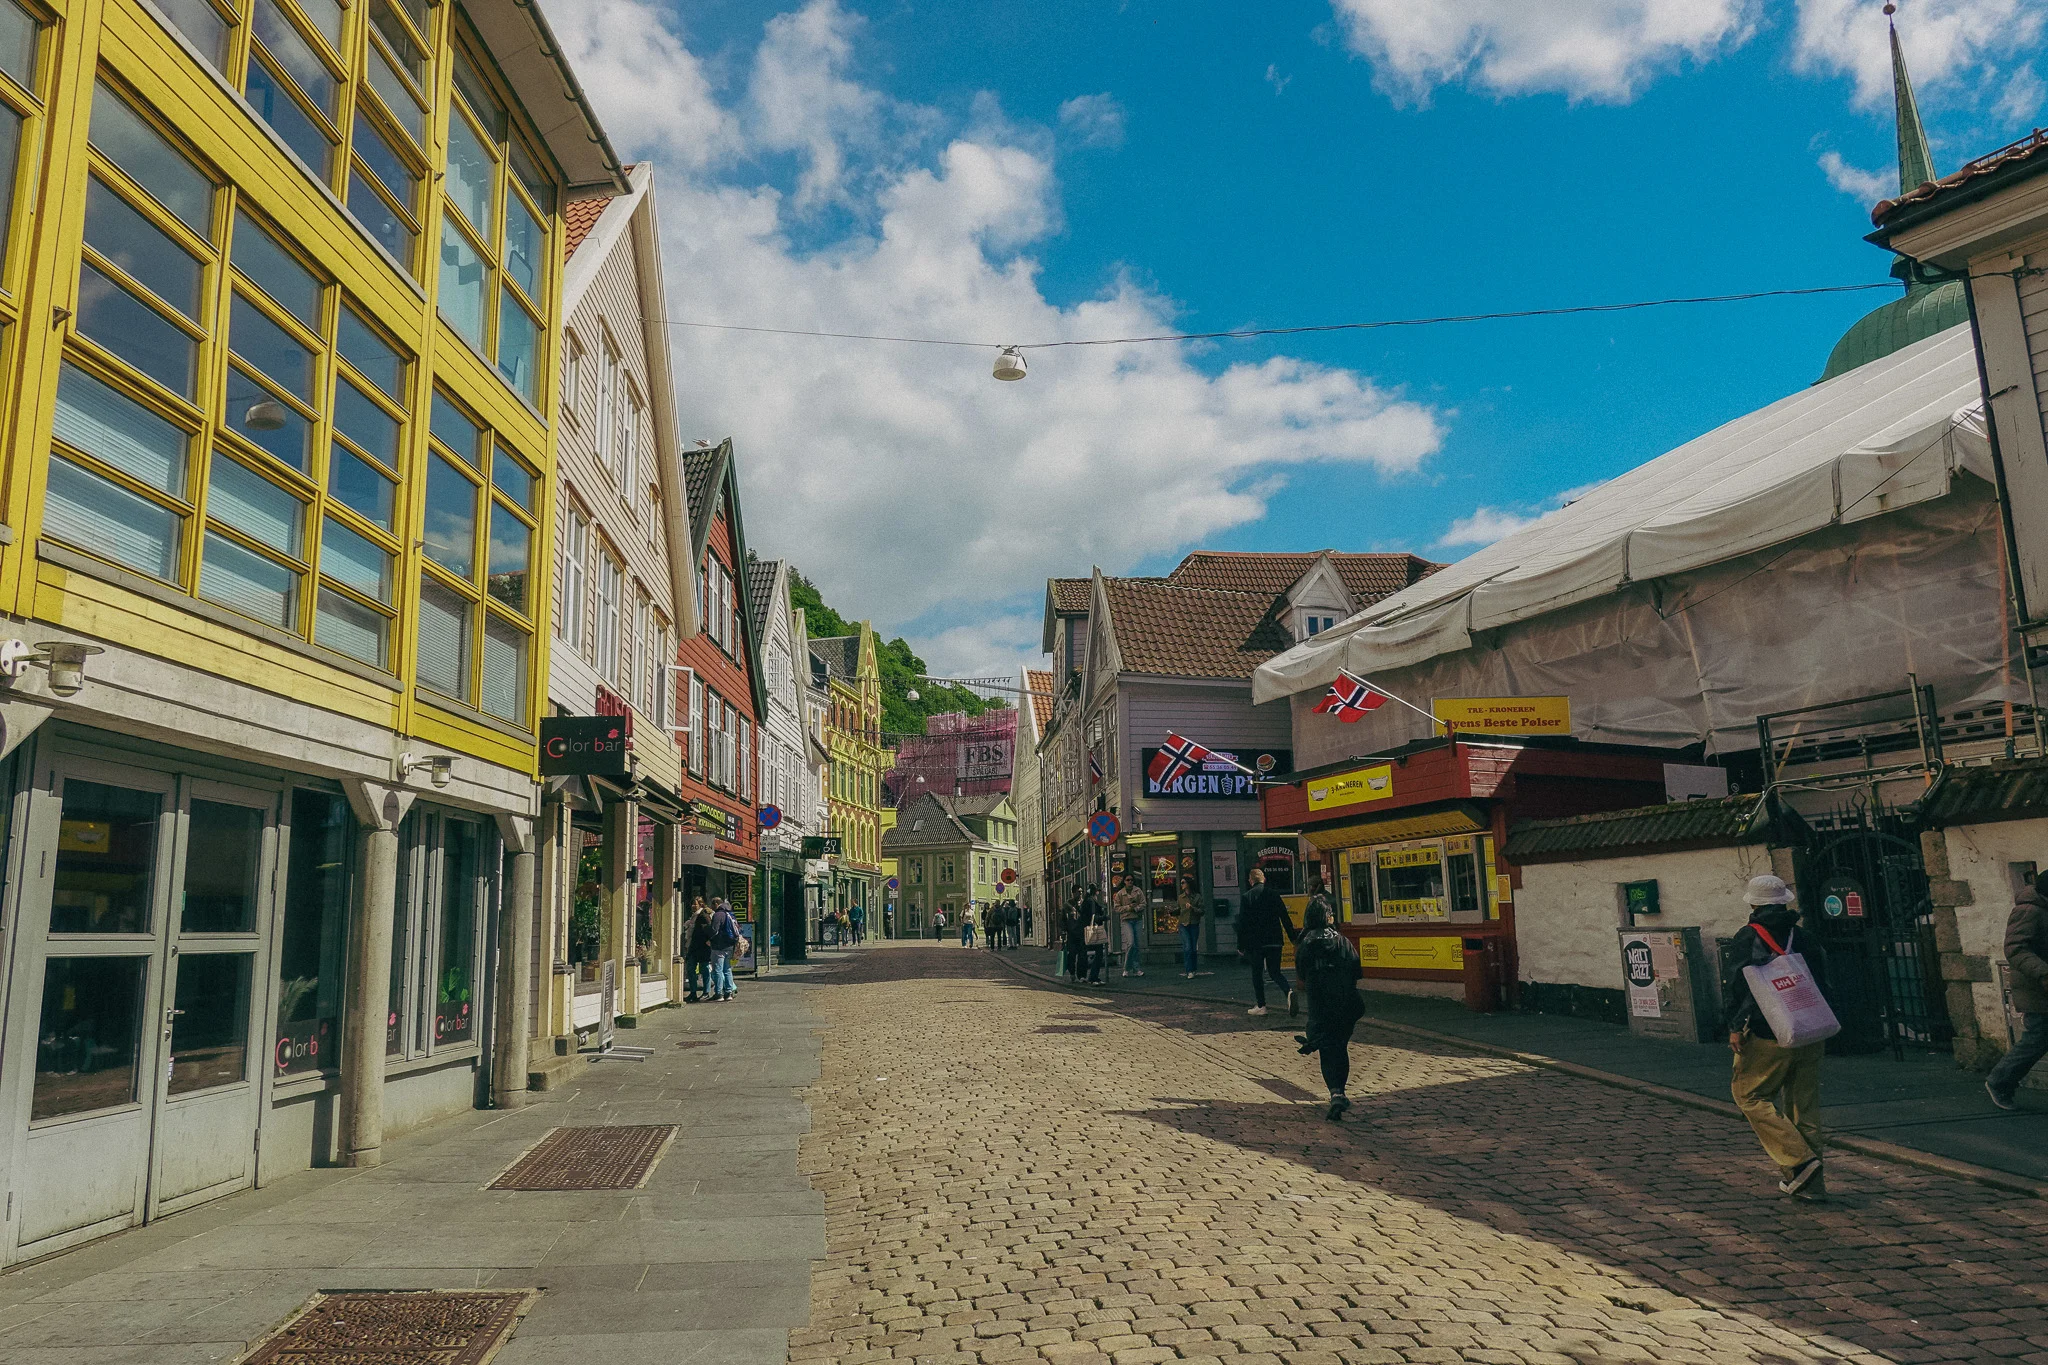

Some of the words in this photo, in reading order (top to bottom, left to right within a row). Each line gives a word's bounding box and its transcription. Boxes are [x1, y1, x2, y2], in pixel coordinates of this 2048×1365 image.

[1483, 718, 1518, 727] Beste
[1521, 717, 1562, 727] Pølser
[594, 737, 621, 752] bar
[964, 744, 1004, 764] FBS
[1149, 775, 1219, 794] BRGEN
[1279, 846, 1294, 856] PIZZA
[1154, 878, 1173, 887] OPEN
[1775, 978, 1792, 988] HH
[456, 1014, 469, 1031] bar
[387, 1027, 396, 1042] ar
